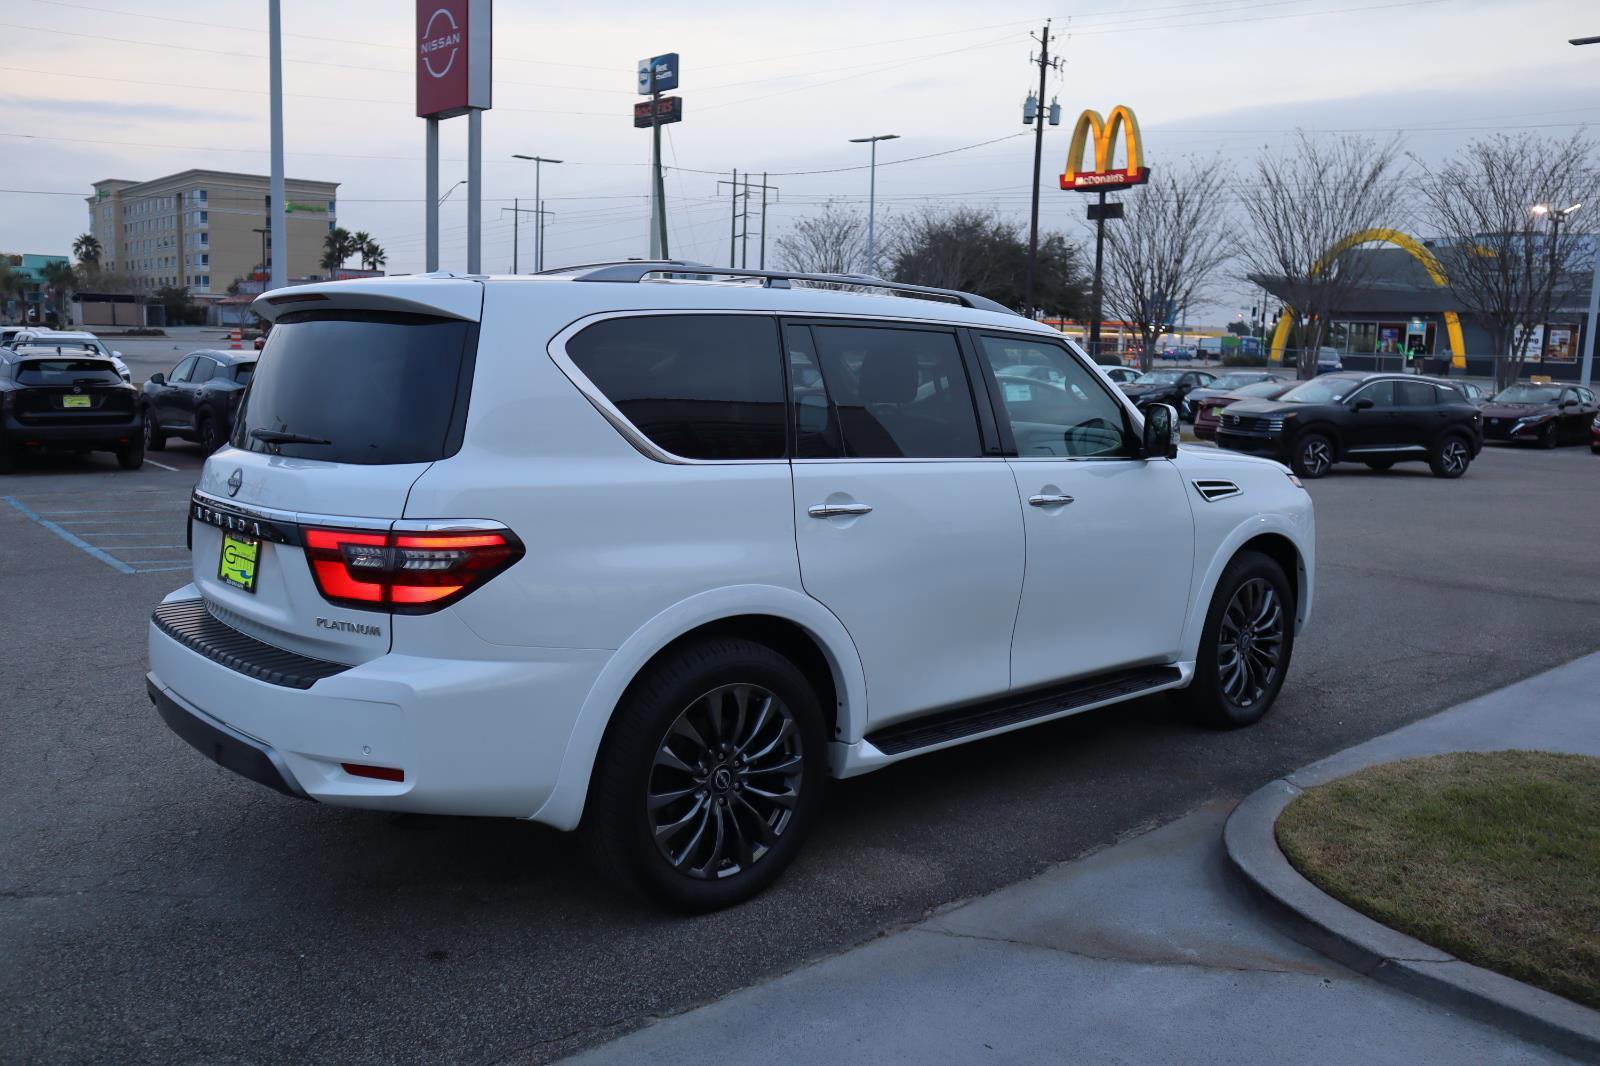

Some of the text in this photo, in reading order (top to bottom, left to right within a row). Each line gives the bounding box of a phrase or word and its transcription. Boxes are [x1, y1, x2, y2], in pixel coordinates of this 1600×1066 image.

[421, 32, 461, 54] NISSAN
[1075, 173, 1125, 186] McDonald's
[195, 506, 260, 537] ARMADA
[315, 616, 382, 637] PLATINUM
